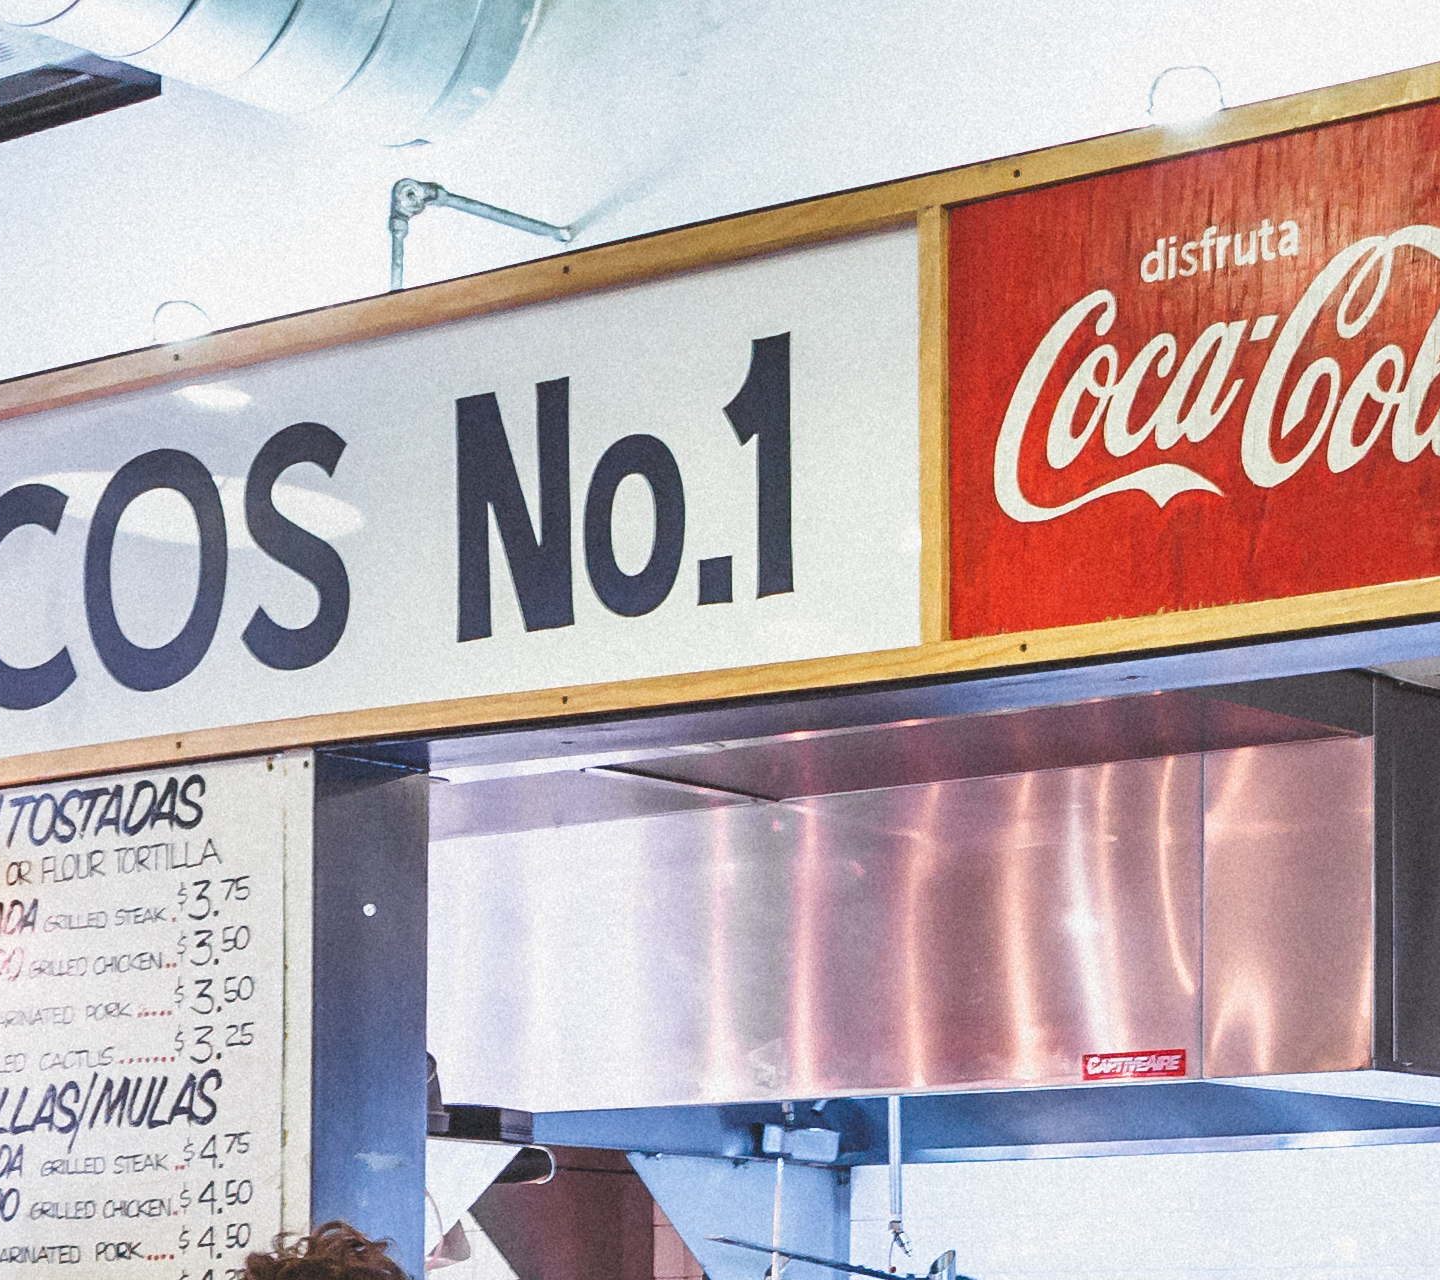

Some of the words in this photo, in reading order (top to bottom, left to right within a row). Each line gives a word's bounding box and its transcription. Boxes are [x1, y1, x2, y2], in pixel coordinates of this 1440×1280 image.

[1140, 213, 1300, 284] disfruta
[454, 330, 795, 645] No.1
[5, 860, 33, 887] OR
[40, 849, 106, 884] FLOUR
[115, 838, 223, 877] TORTILLA
[114, 906, 167, 927] STEAK
[177, 874, 251, 921] $3.75
[92, 950, 164, 976] CHICKEN
[176, 923, 251, 967] $3.50
[85, 1001, 133, 1022] PORK
[173, 973, 255, 1016] $3.50
[38, 1045, 116, 1072] CACTUS
[173, 1021, 255, 1065] $3.25
[40, 1155, 106, 1178] GRILLED
[112, 1153, 170, 1175] STEAK
[182, 1130, 252, 1170] $4.75
[29, 1198, 97, 1221] GRILLED
[102, 1197, 173, 1219] CHICKEN
[179, 1178, 254, 1216] $4.50
[95, 1241, 145, 1262] PORK
[178, 1222, 253, 1260] $4.50
